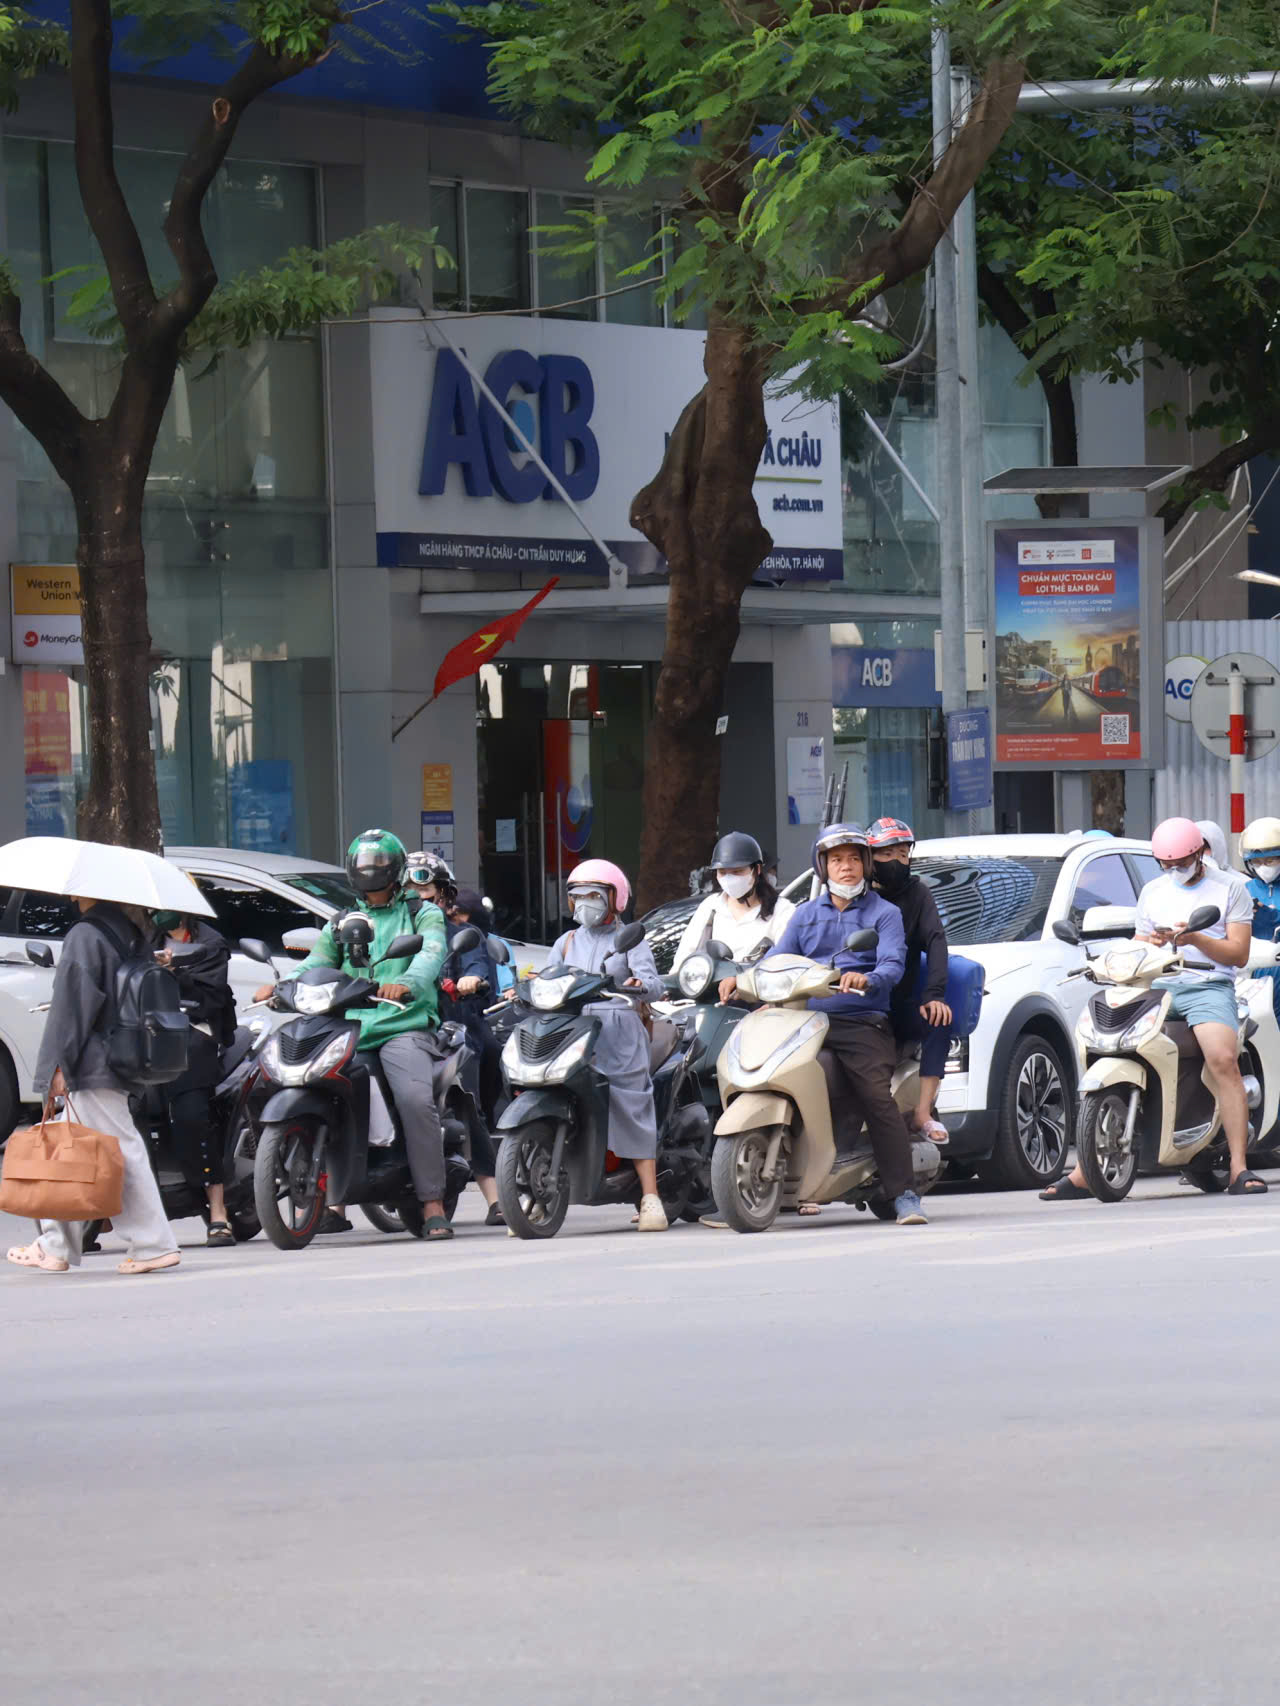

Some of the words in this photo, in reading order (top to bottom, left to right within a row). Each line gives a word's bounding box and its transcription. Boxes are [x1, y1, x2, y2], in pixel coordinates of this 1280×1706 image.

[418, 347, 600, 504] ACB
[777, 431, 822, 467] CHÂU
[773, 494, 824, 512] acb.com.vn
[419, 540, 441, 557] NGÂN
[442, 541, 463, 558] HÀNG
[464, 545, 485, 559] TMCP
[492, 544, 513, 559] CHÂU
[518, 549, 529, 561] CN
[530, 545, 549, 561] TRẦN
[550, 550, 564, 562] DUY
[792, 557, 802, 568] TP.
[803, 554, 812, 568] HÀ
[813, 554, 825, 572] NỘI
[26, 579, 72, 589] Western
[41, 591, 72, 600] Union
[41, 634, 81, 645] MoneyGr
[861, 658, 893, 687] ACB
[1165, 678, 1194, 700] AC
[797, 712, 808, 727] 216
